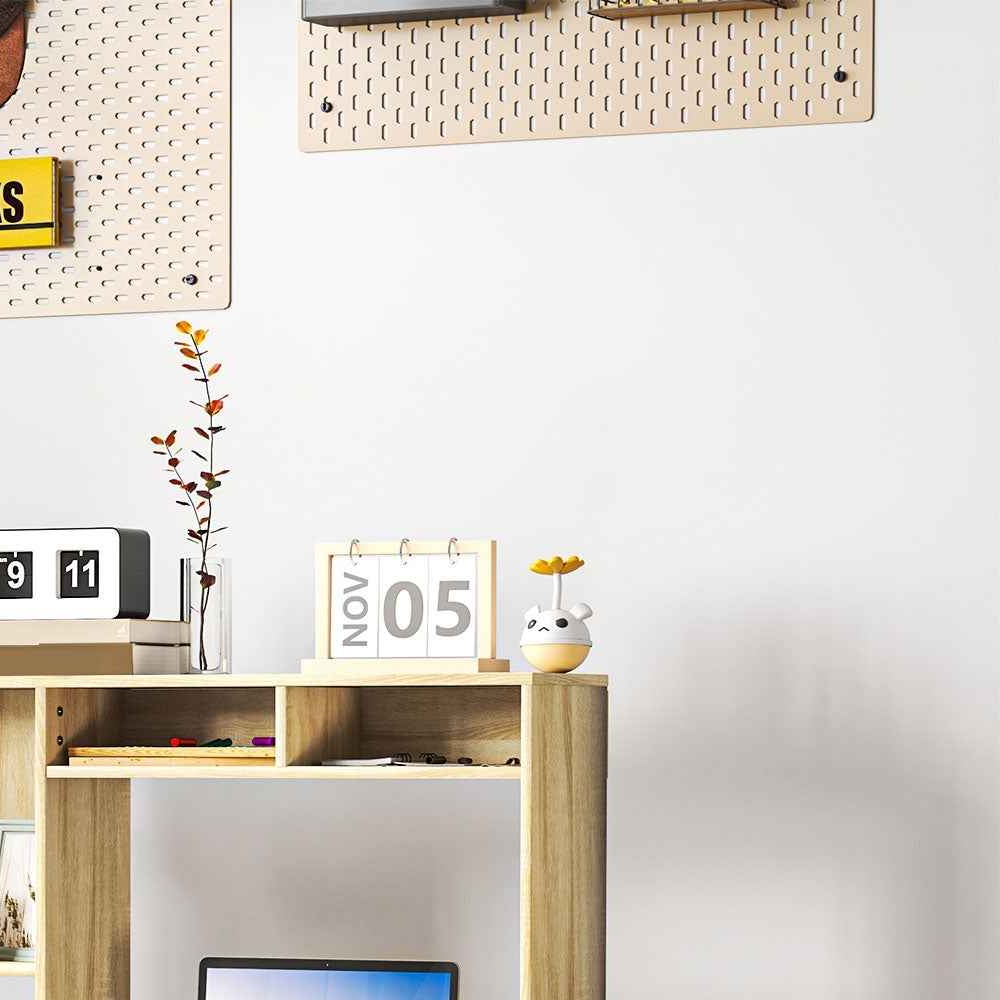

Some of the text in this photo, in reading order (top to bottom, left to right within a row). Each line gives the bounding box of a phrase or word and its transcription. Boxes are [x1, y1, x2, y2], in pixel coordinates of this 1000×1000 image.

[7, 559, 95, 589] 9 11
[343, 571, 472, 647] NOV 05
